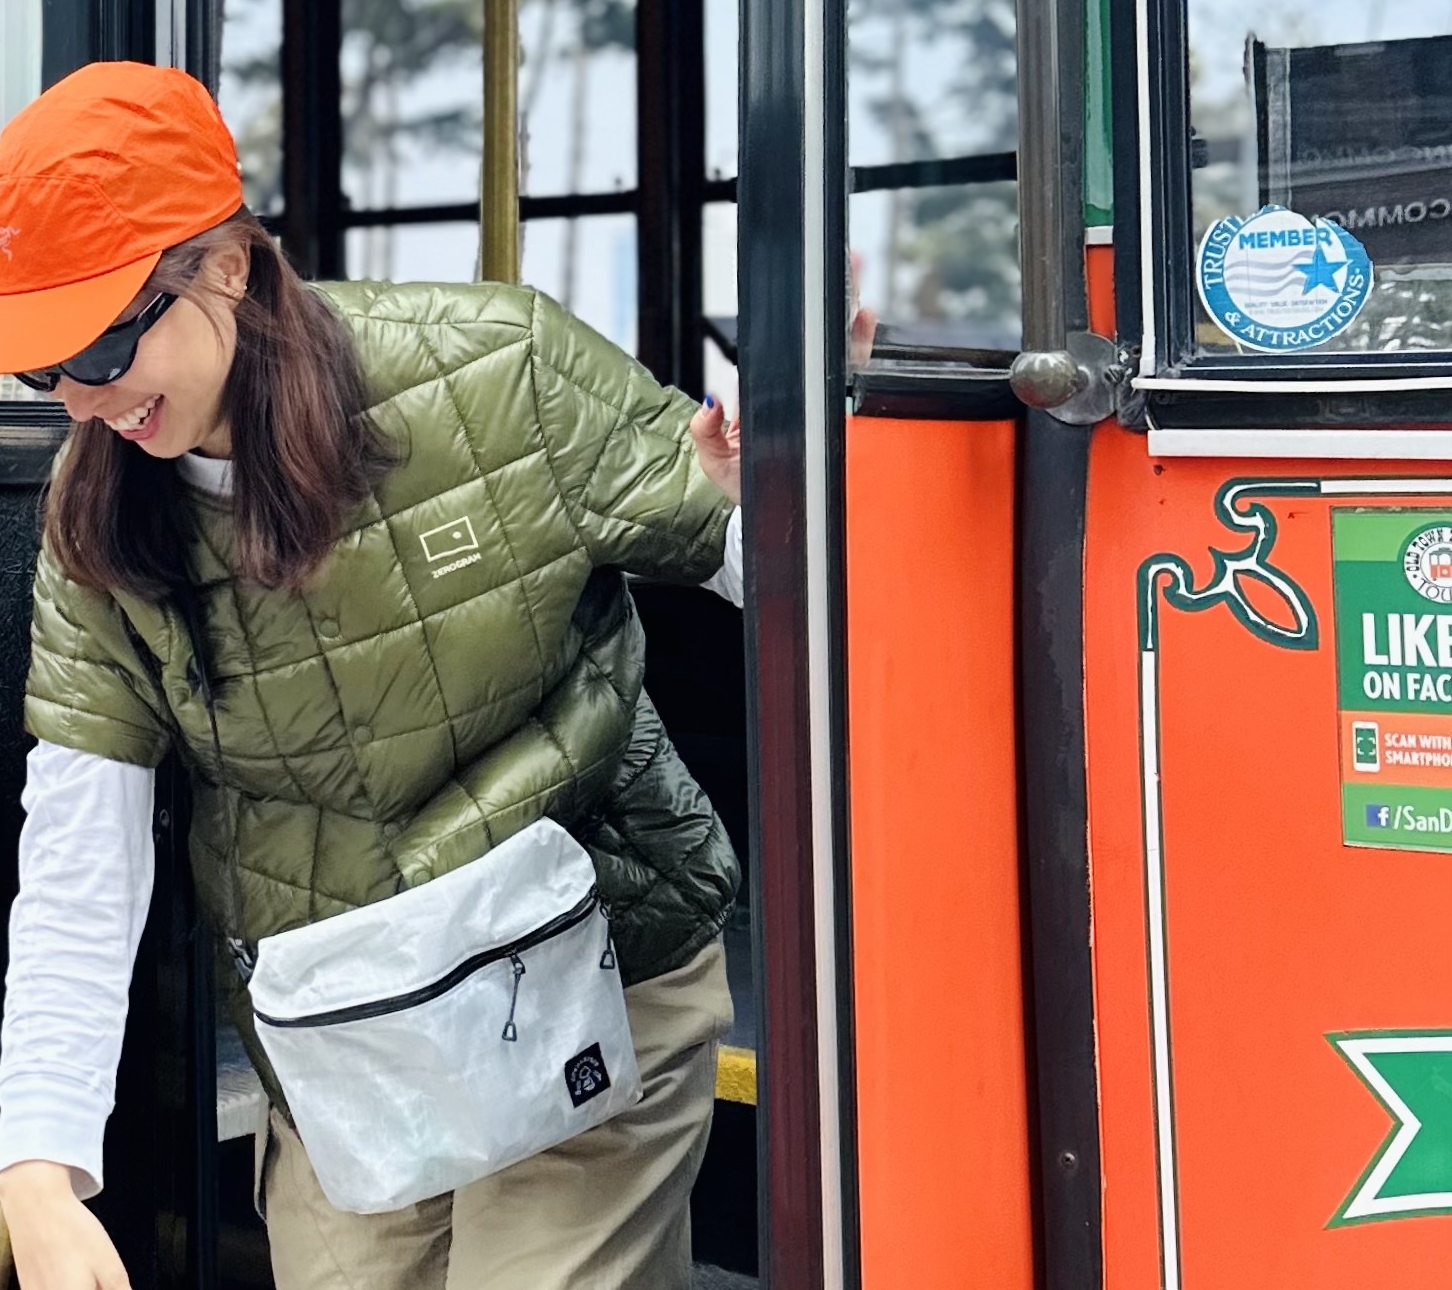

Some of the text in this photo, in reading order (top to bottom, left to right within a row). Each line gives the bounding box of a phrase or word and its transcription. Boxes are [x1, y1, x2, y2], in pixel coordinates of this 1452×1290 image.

[1239, 227, 1333, 250] MEMBER
[1240, 272, 1365, 346] ATTRACTIONS
[1362, 612, 1452, 668] LIKE
[1363, 670, 1401, 700] ON
[1384, 732, 1451, 750] SCAN WITH
[1385, 749, 1452, 767] SMARTPHO
